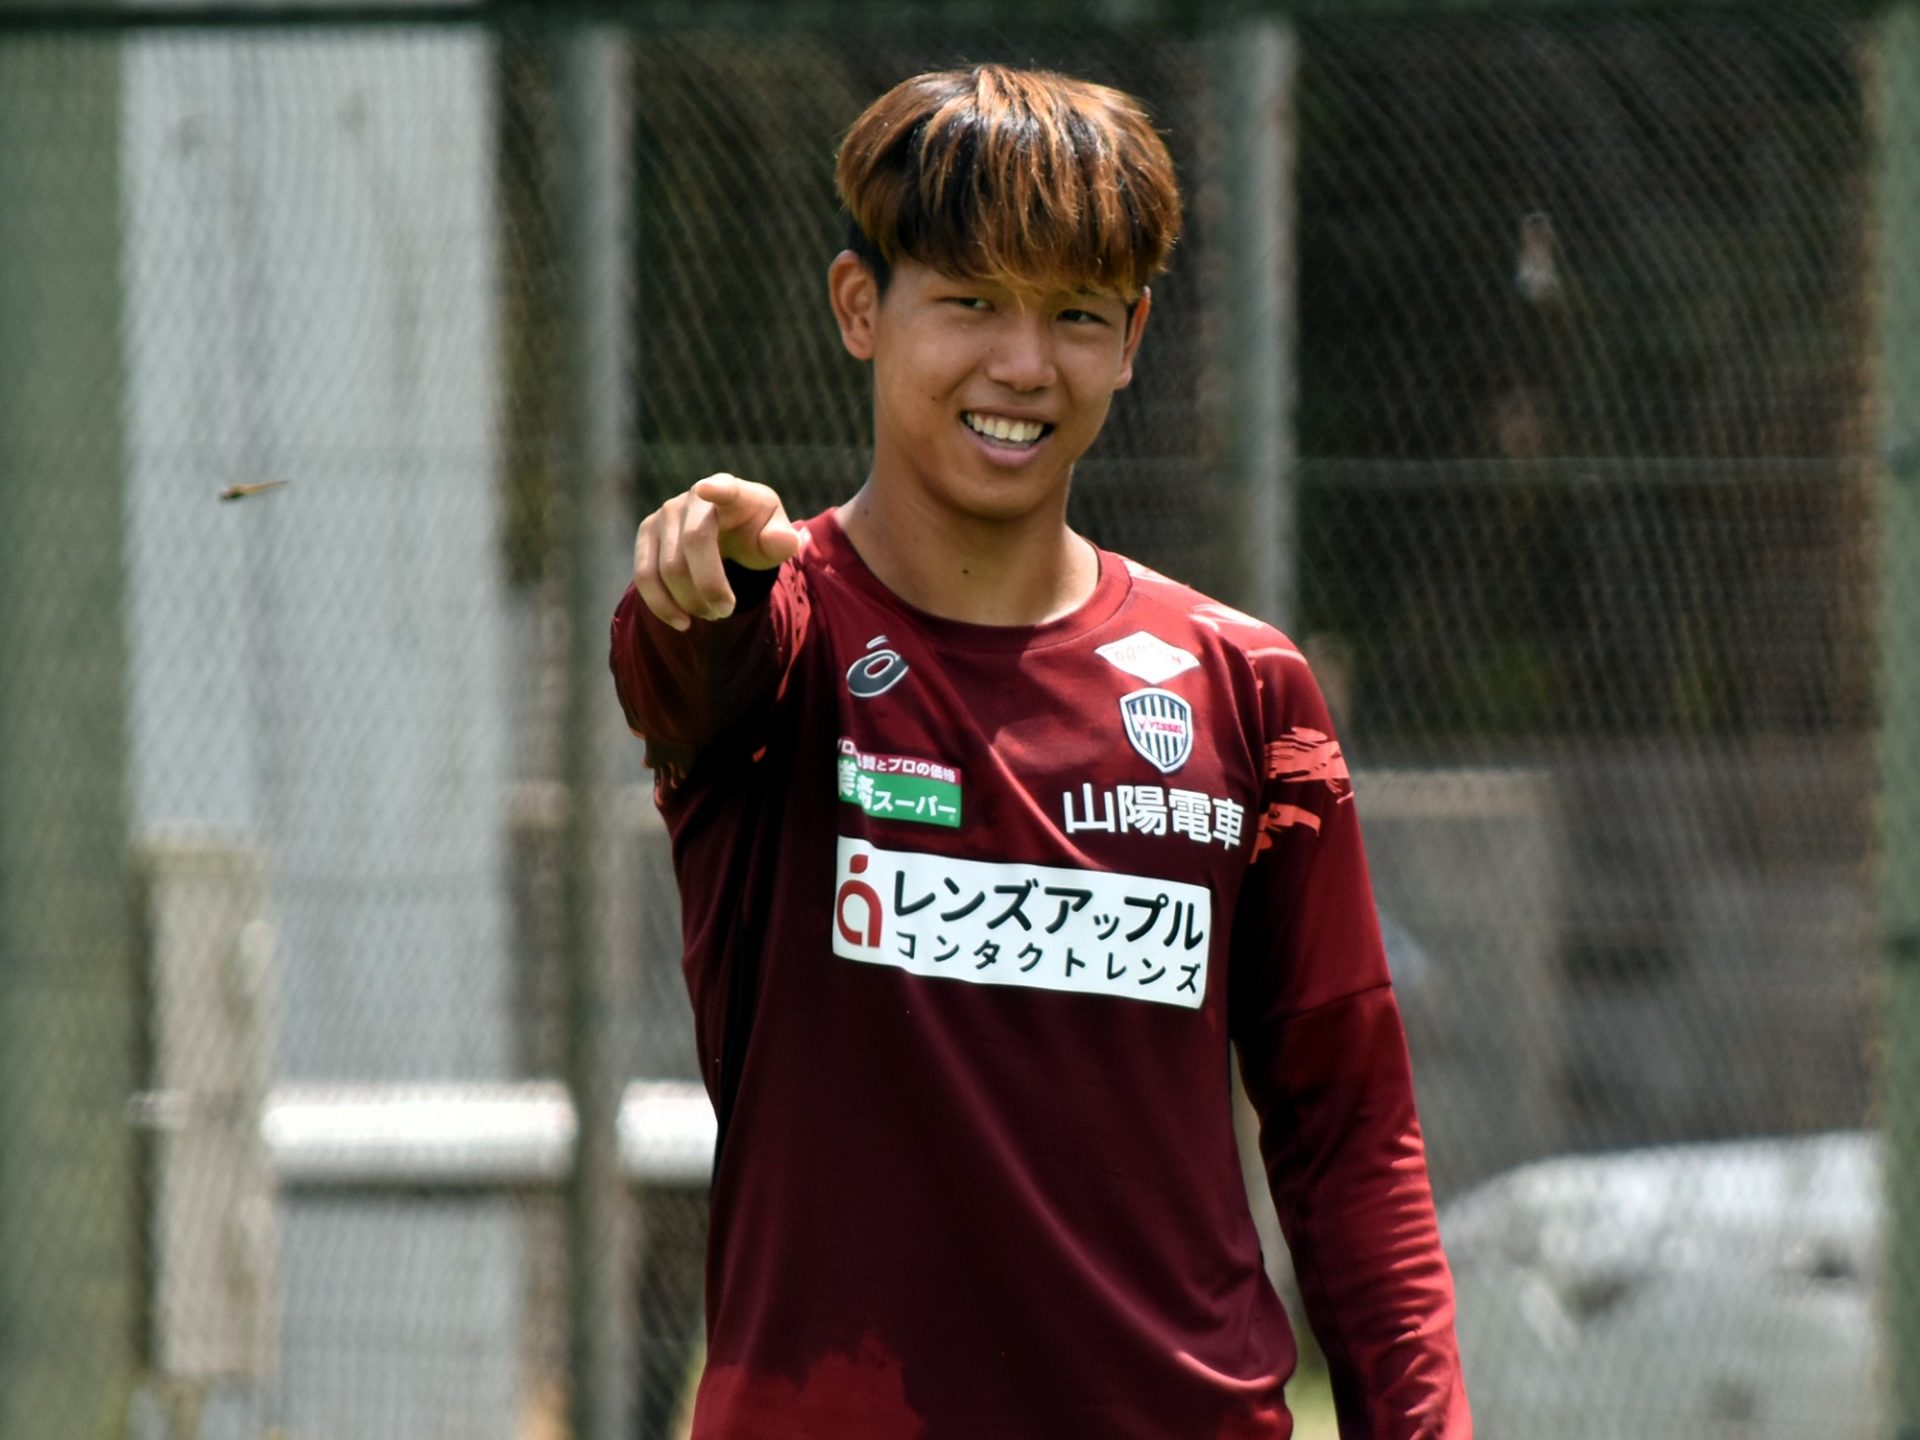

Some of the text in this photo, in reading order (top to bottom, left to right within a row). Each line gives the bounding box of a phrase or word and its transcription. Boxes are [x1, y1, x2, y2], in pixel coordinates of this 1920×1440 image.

[1062, 782, 1245, 851] 山陽電車
[893, 869, 1204, 951] レンズアップル
[895, 930, 1202, 994] コンタクトレンズ
